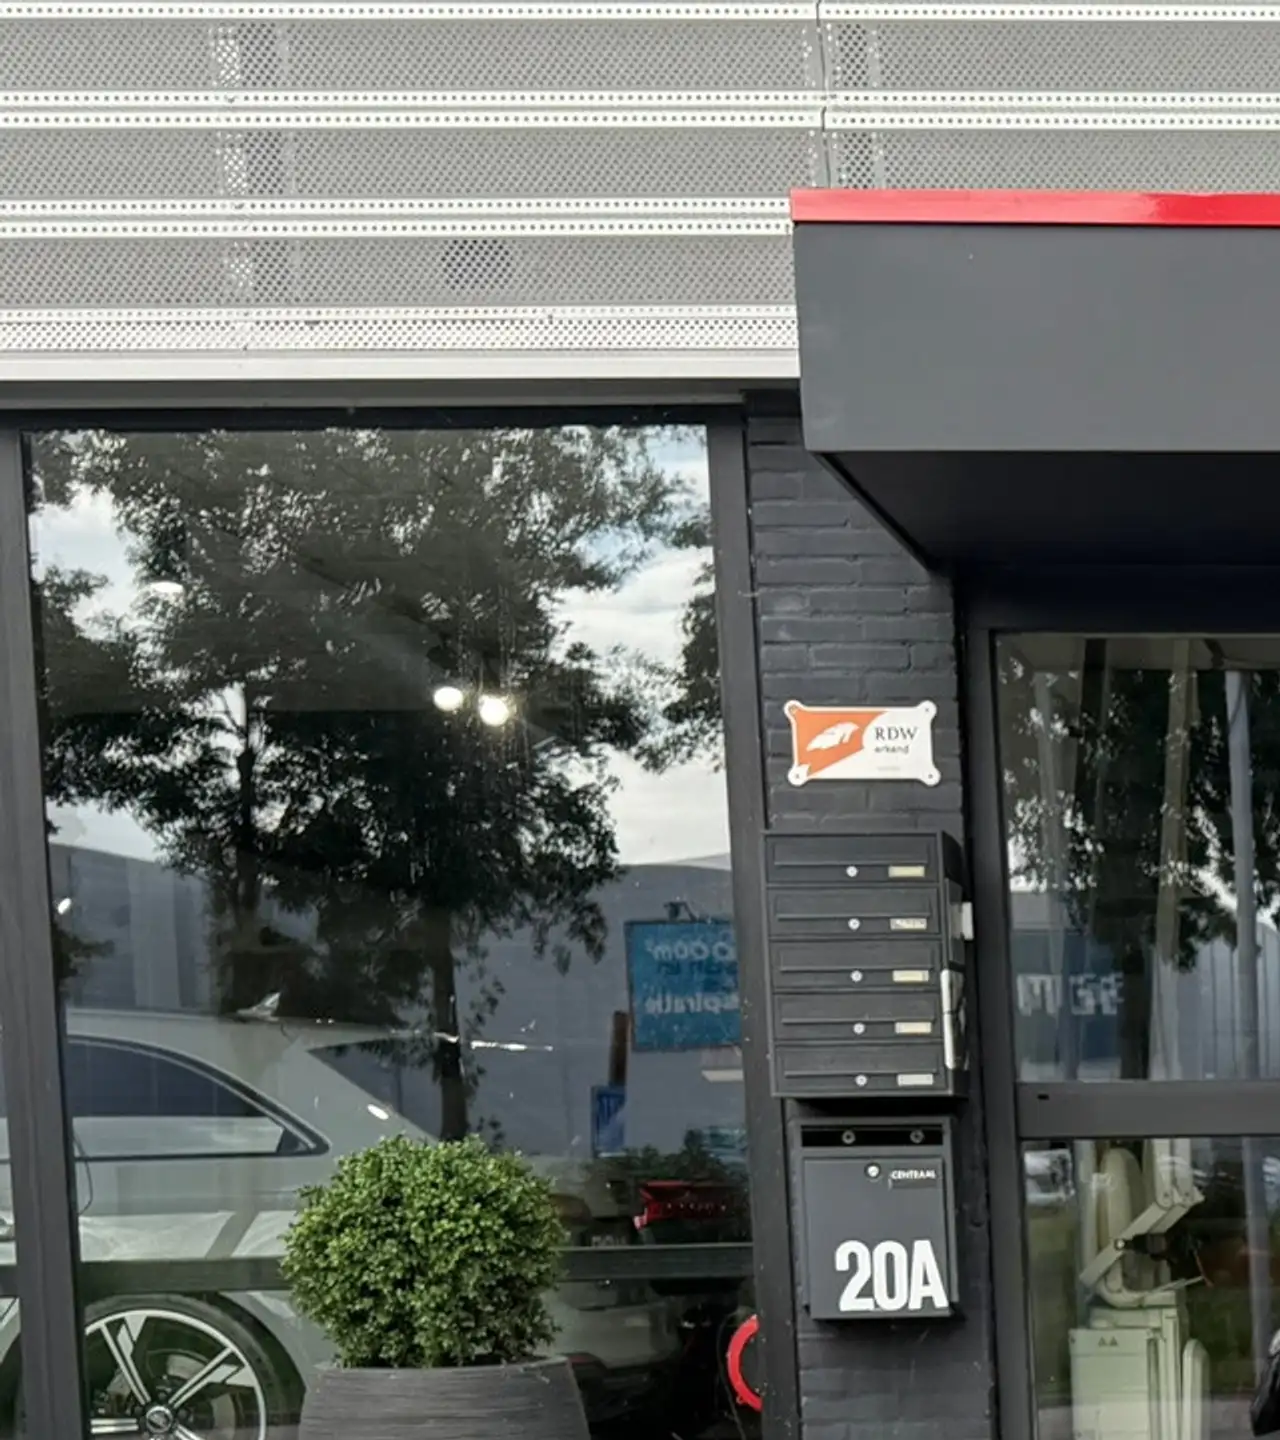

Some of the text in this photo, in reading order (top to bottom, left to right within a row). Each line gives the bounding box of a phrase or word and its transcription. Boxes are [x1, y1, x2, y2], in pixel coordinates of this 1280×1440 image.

[875, 727, 917, 740] RDW
[890, 1169, 936, 1180] CENTRAAL
[835, 1239, 949, 1312] 20A
